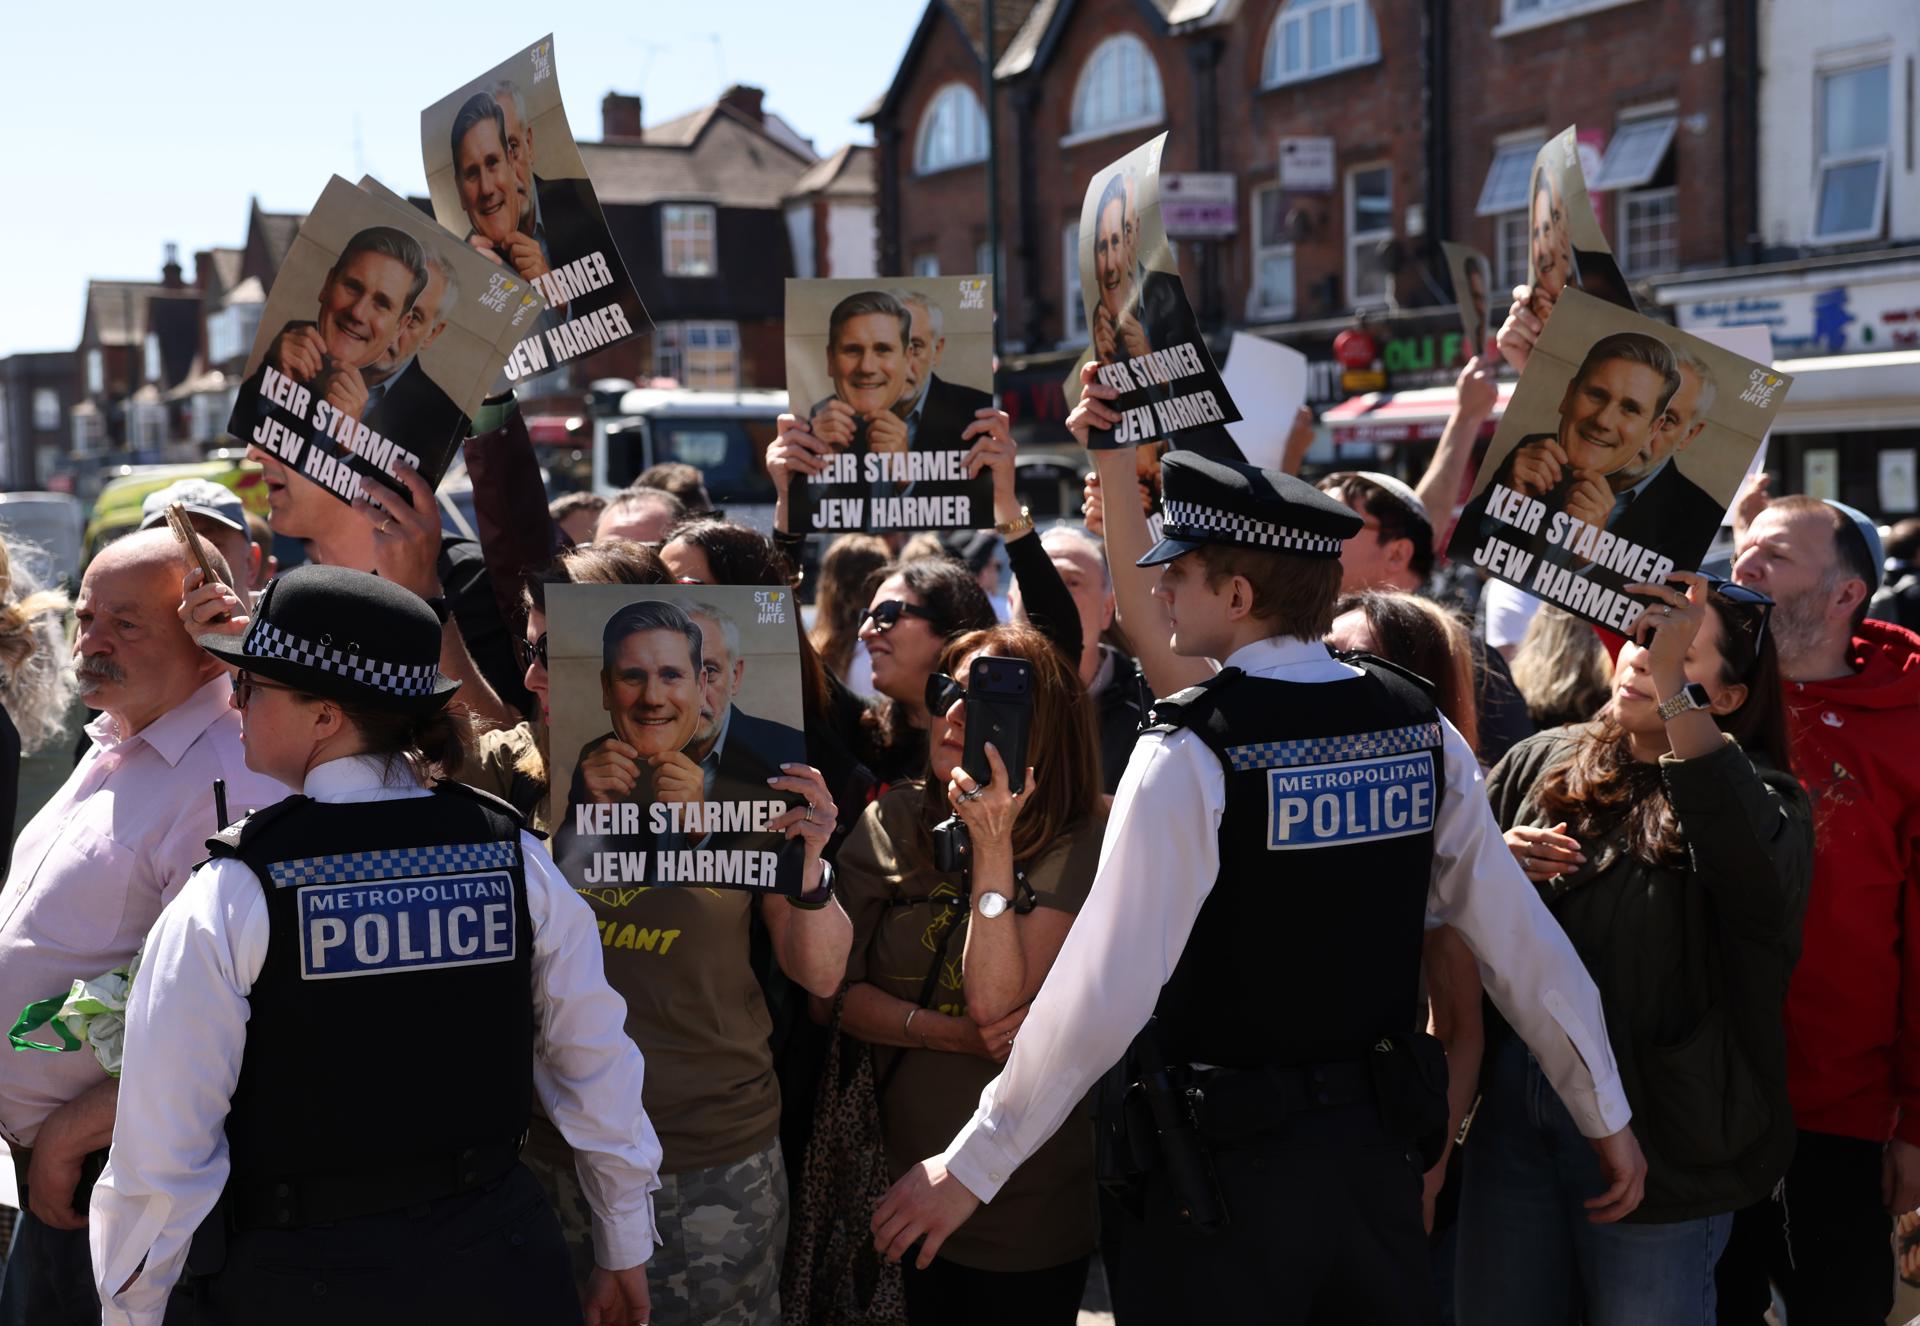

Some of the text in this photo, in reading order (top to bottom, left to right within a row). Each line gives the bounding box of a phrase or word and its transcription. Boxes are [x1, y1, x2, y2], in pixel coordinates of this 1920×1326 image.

[490, 284, 510, 302] THE
[530, 251, 614, 310] TARMER
[478, 292, 506, 312] HATE
[504, 335, 549, 381] JEW
[545, 303, 633, 362] HARMER
[1129, 342, 1205, 388] STARMER
[1749, 369, 1784, 389] STOP
[260, 366, 311, 420] KEIR
[1739, 389, 1770, 408] HATE
[1751, 381, 1775, 397] THE
[1115, 390, 1225, 443] JEW HARMER
[253, 416, 384, 512] JEW HARM
[812, 496, 970, 528] JEW HARMER
[1485, 484, 1674, 586] KEIR STARMER
[754, 591, 785, 603] STOP
[1473, 536, 1645, 632] JEW HARMER
[757, 612, 785, 624] HATE
[759, 602, 782, 612] THE
[1279, 762, 1429, 793] METROPOLITAN
[576, 800, 787, 835] KEIR STARMER
[1278, 781, 1430, 841] POLICE
[584, 850, 778, 887] JEW HARMER
[309, 881, 506, 912] METROPOLITAN
[310, 903, 508, 969] POLICE
[597, 921, 681, 955] IANT
